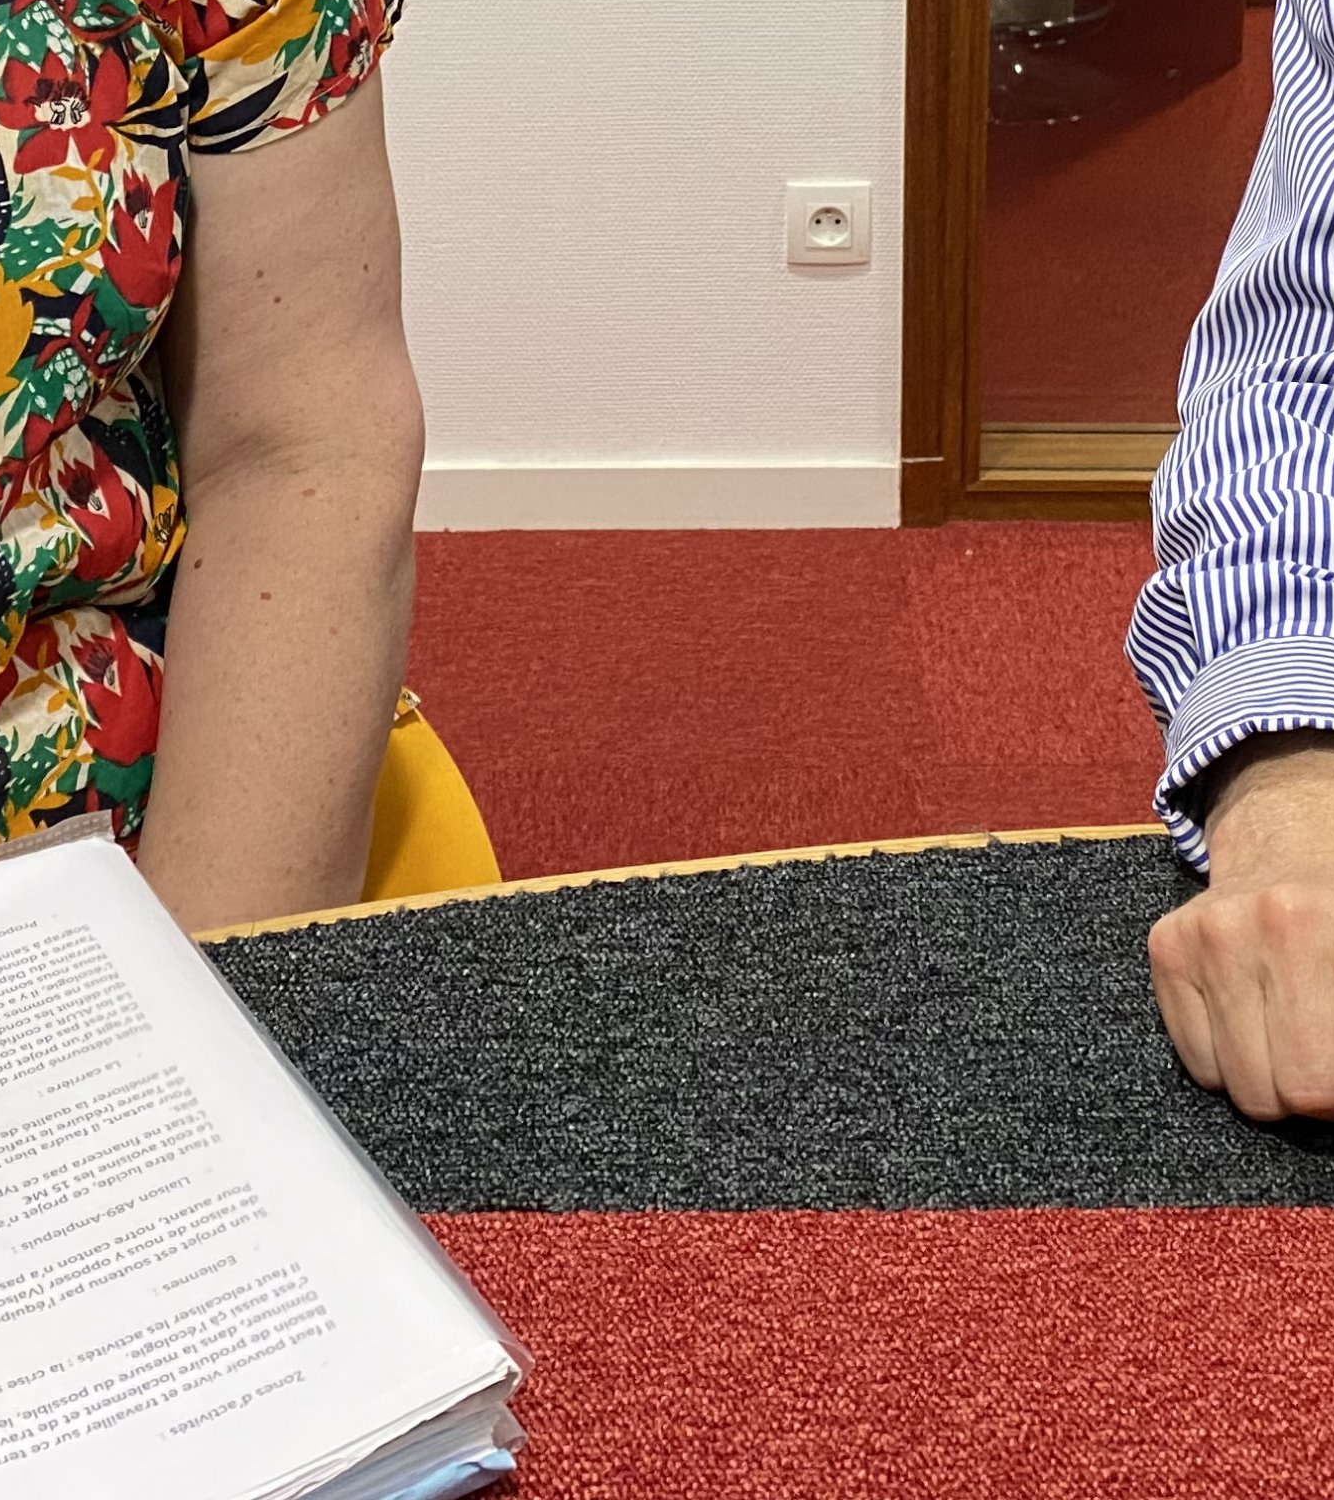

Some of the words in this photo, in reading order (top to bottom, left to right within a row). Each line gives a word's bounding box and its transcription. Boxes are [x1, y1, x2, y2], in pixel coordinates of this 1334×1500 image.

[30, 988, 38, 1000] il
[3, 992, 61, 1019] sommes
[34, 1007, 53, 1021] les
[19, 1041, 32, 1052] la
[36, 1034, 53, 1046] de
[16, 1041, 58, 1067] projet
[13, 1059, 44, 1080] pour
[22, 1103, 71, 1134] qualité
[56, 1100, 113, 1132] (réduire
[0, 1126, 18, 1139] de
[39, 1127, 53, 1138] le
[40, 1126, 88, 1151] faudra
[4, 1146, 36, 1165] bien
[72, 1135, 140, 1169] financera
[98, 1143, 157, 1174] avoisine
[42, 1161, 67, 1180] pas
[73, 1169, 94, 1184] les
[22, 1187, 47, 1207] M€
[51, 1179, 68, 1196] 15
[22, 1191, 68, 1221] projet
[21, 1198, 134, 1251] A89-Amplepuis
[114, 1221, 155, 1246] notre
[167, 1224, 186, 1240] de
[57, 1240, 110, 1269] canton
[127, 1234, 163, 1257] nous
[154, 1244, 177, 1264] est
[49, 1256, 110, 1288] opposer
[88, 1256, 151, 1289] soutenu
[59, 1280, 84, 1301] par
[146, 1317, 168, 1335] les
[77, 1329, 142, 1365] activités
[178, 1334, 246, 1376] produire
[49, 1361, 64, 1375] la
[118, 1350, 178, 1383] mesure
[7, 1368, 45, 1390] crise
[93, 1377, 114, 1393] du
[84, 1369, 174, 1418] localement
[161, 1387, 178, 1405] et
[62, 1409, 80, 1427] et
[86, 1395, 158, 1433] travailler
[37, 1417, 58, 1434] de
[55, 1427, 80, 1446] sur
